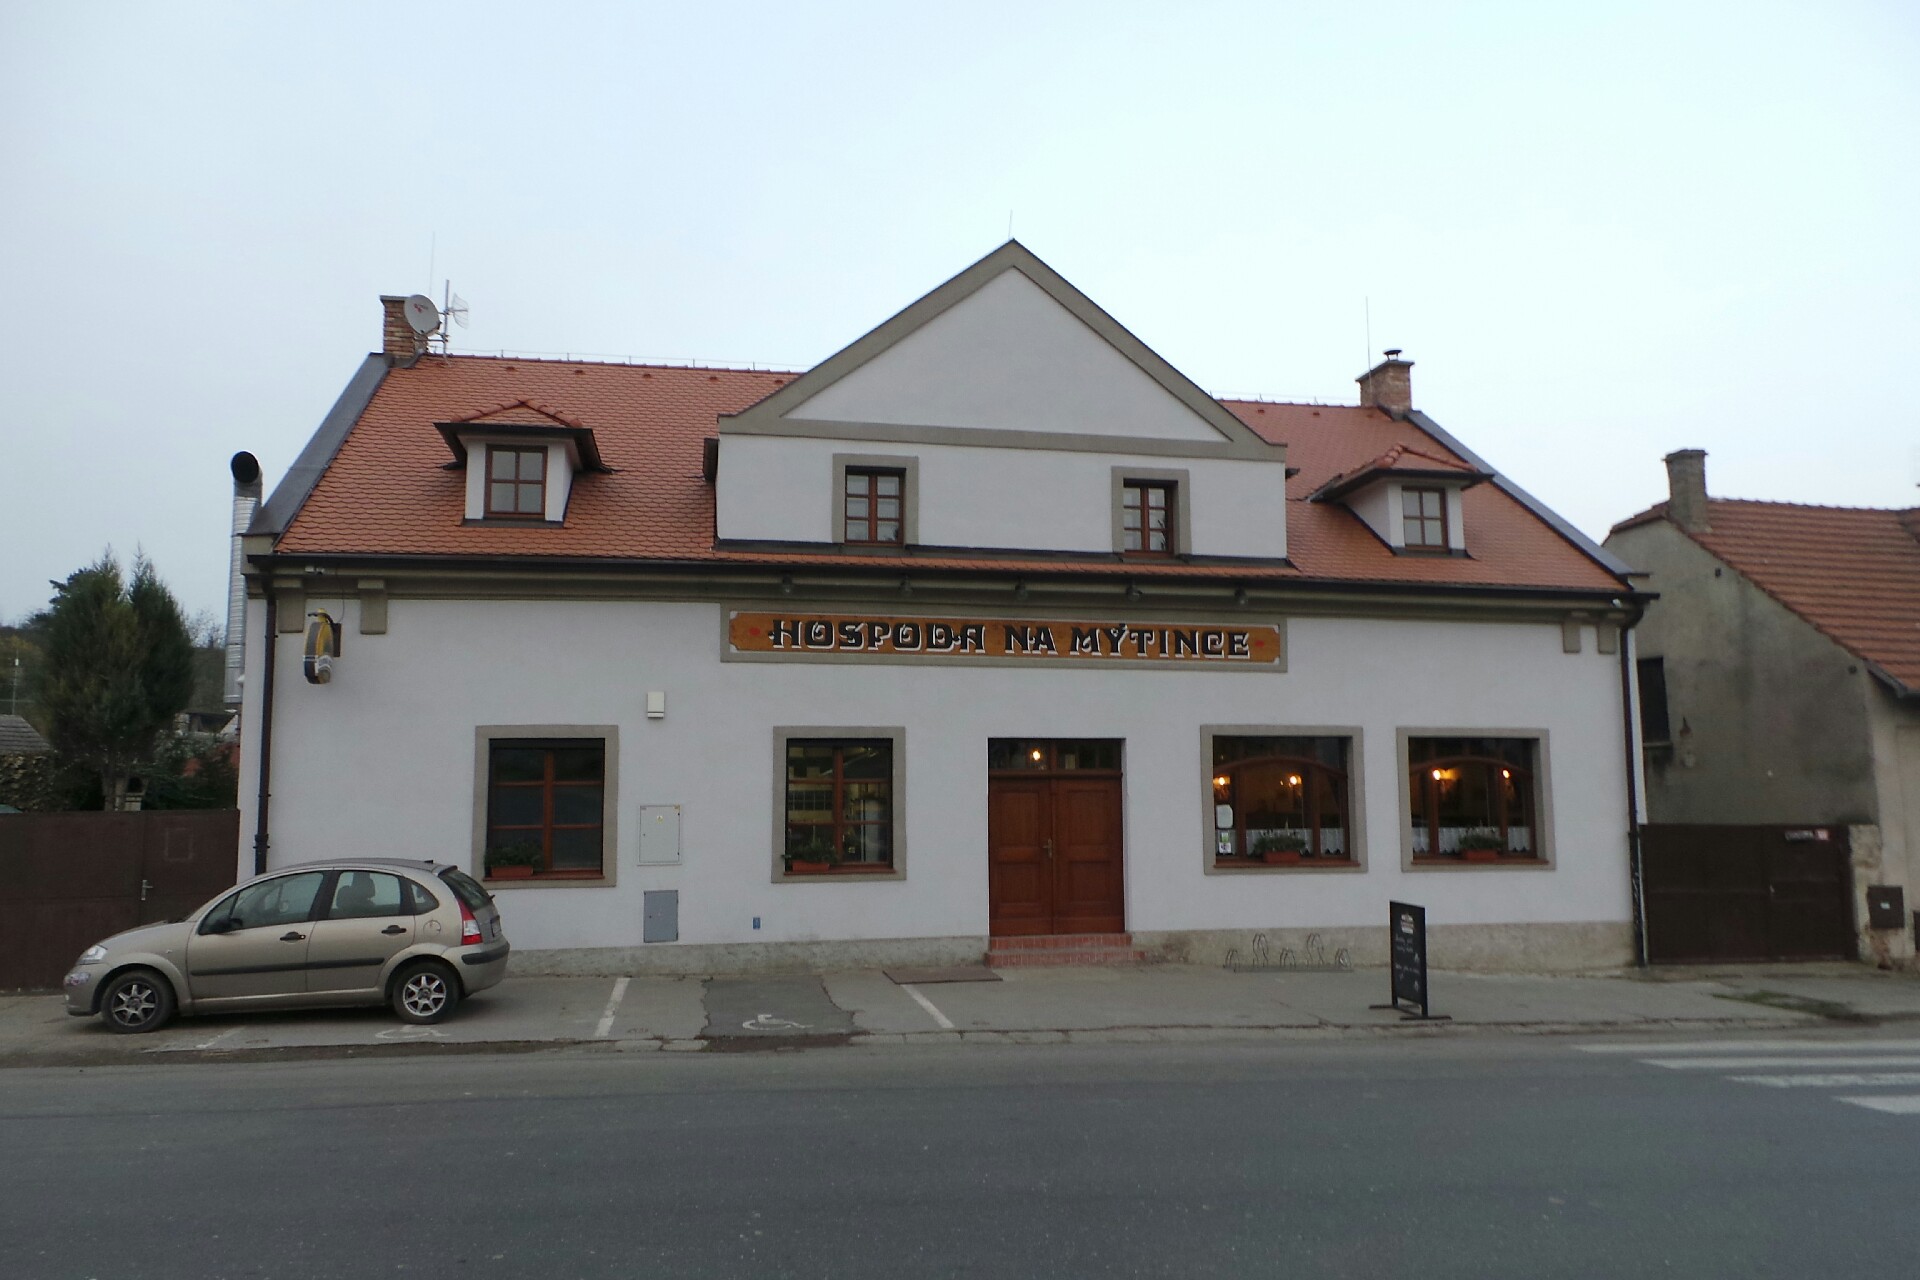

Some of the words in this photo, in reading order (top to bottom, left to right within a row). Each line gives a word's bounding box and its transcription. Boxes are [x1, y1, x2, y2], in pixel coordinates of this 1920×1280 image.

[768, 619, 985, 653] HOSPODA
[1003, 624, 1058, 655] NA
[1069, 622, 1250, 659] MÝTINCE
